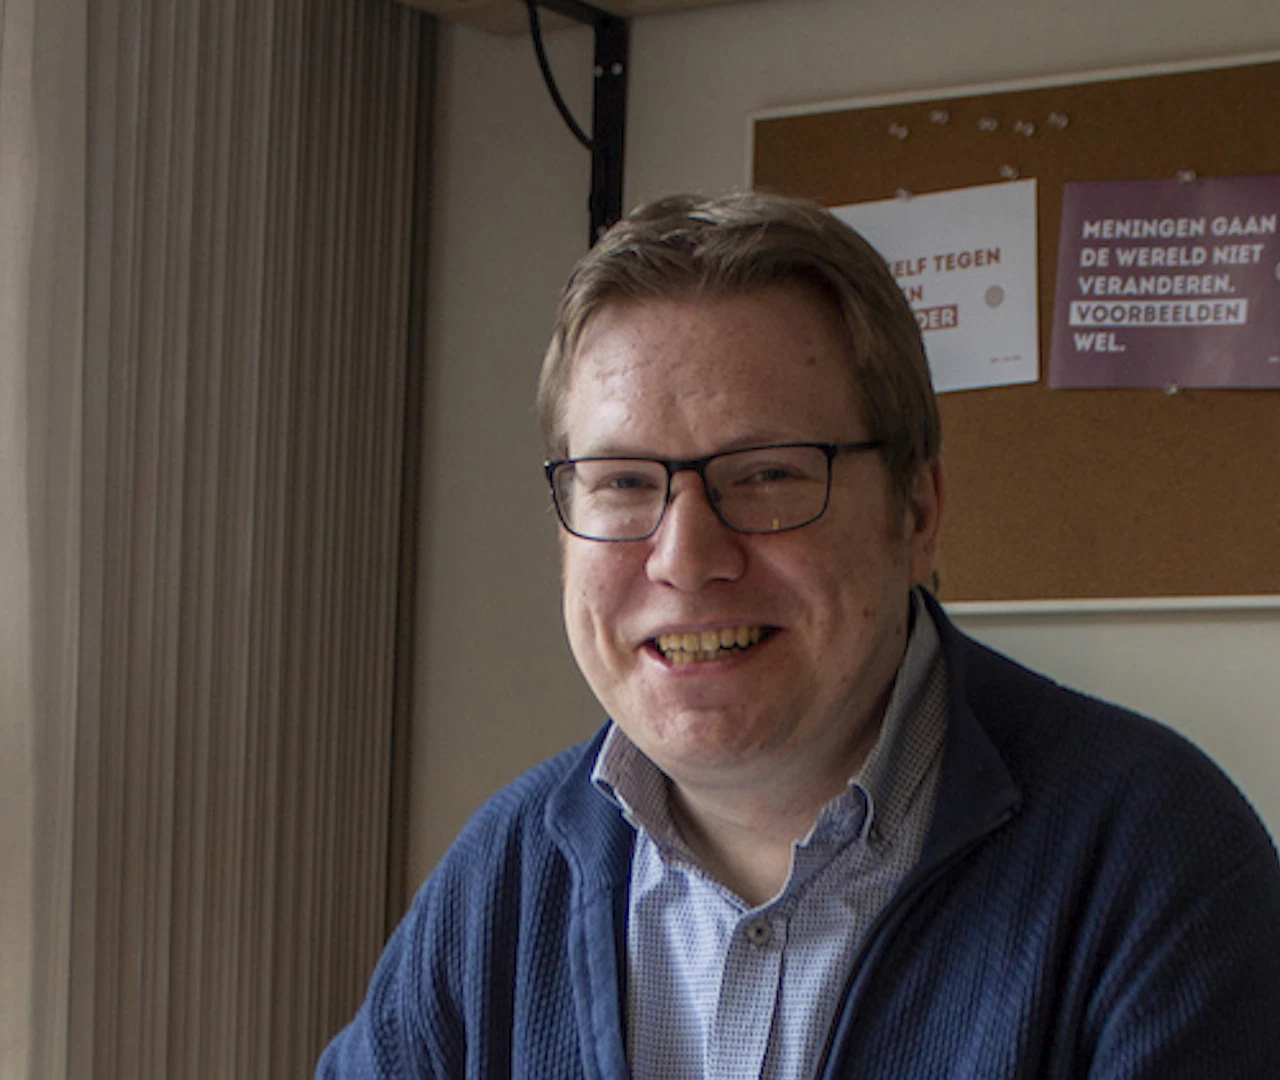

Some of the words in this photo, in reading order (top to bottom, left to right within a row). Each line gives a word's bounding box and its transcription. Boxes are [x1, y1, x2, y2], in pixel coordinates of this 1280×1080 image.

[1082, 217, 1206, 240] MENINGEN
[1211, 213, 1277, 237] GAAN
[888, 256, 927, 279] ELF
[933, 247, 1001, 272] TEGEN
[1080, 247, 1110, 268] DE
[1116, 246, 1208, 268] WERELD
[1213, 243, 1265, 266] NIET
[1078, 273, 1236, 296] VERANDEREN.
[1076, 303, 1241, 324] VOORBEELDEN
[1074, 332, 1127, 353] WEL.
